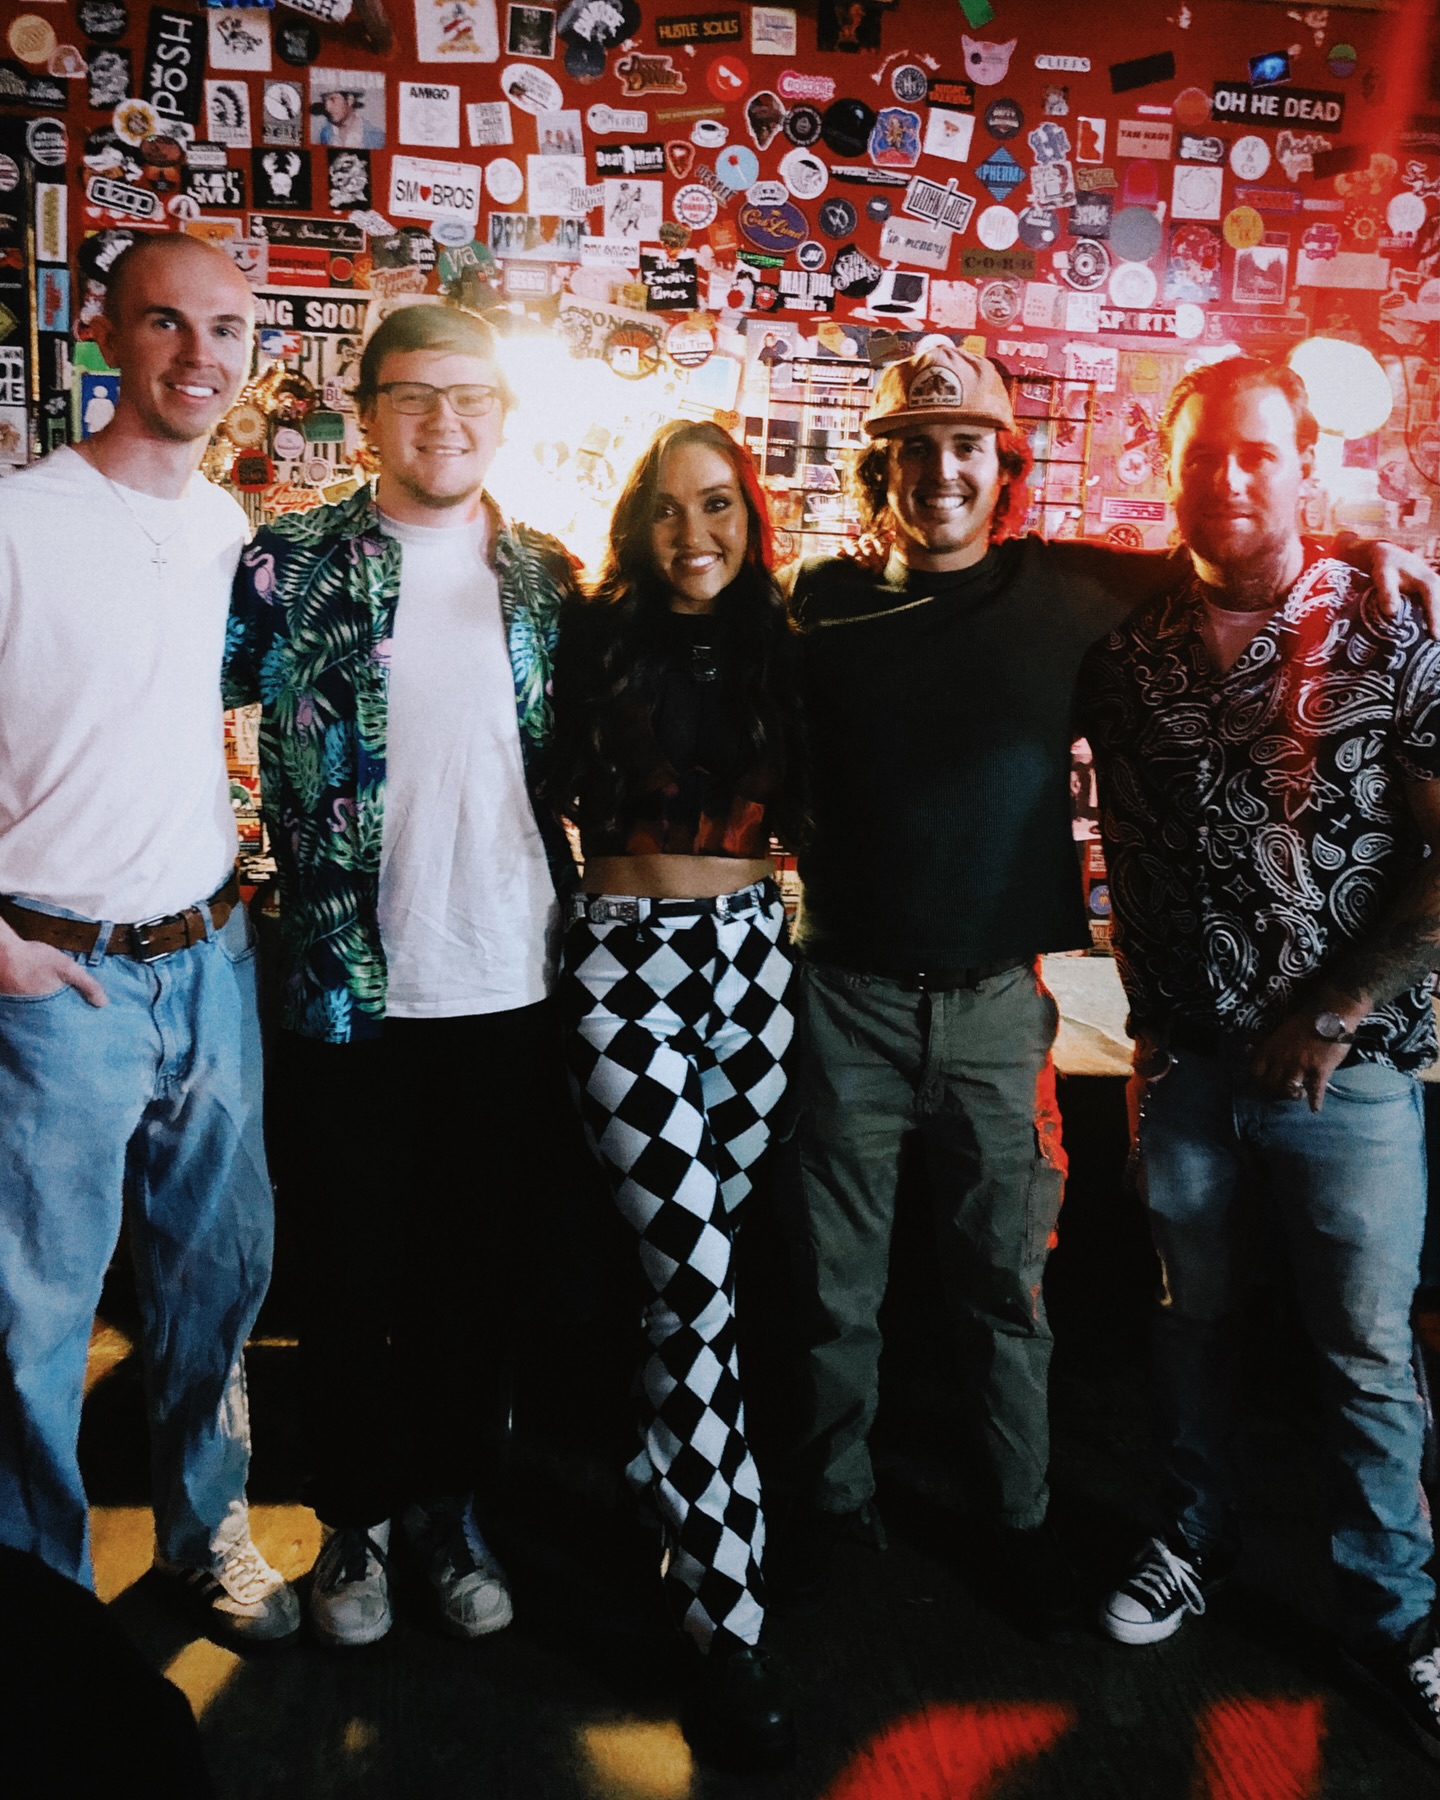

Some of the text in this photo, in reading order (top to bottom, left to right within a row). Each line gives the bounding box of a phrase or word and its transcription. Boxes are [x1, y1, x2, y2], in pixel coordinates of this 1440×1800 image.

[659, 22, 698, 41] HUSTLE
[702, 19, 739, 36] SOULS
[150, 14, 193, 117] POSH
[409, 86, 450, 99] AMIGO
[1214, 89, 1341, 123] OH HE DEAD
[596, 146, 664, 168] Bear Mark
[432, 184, 475, 210] BROS
